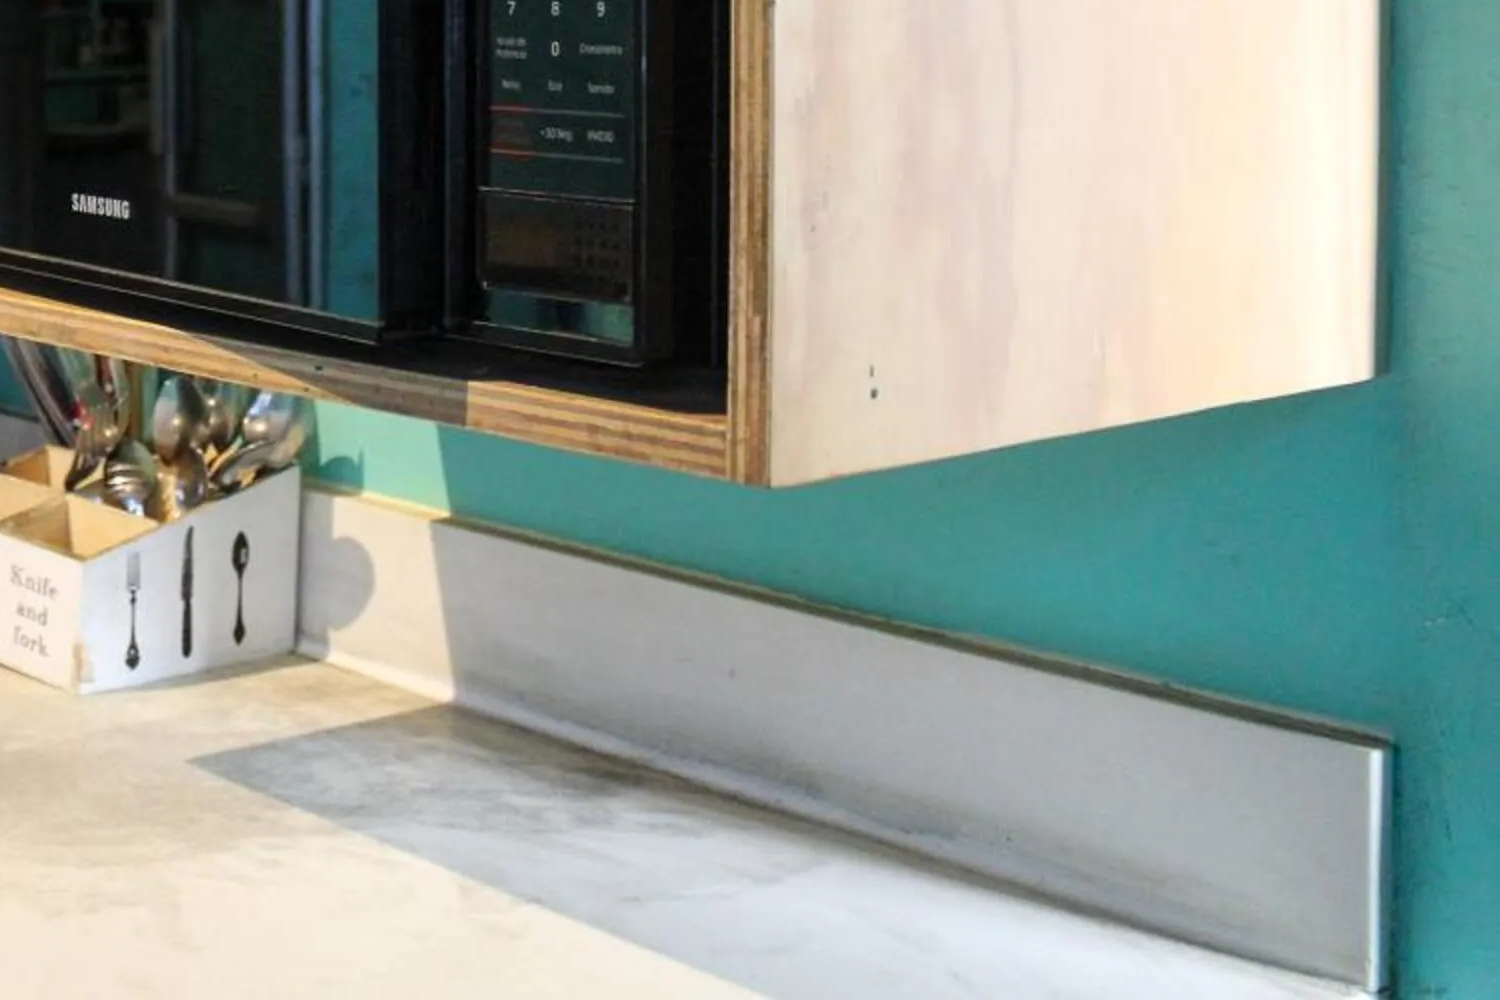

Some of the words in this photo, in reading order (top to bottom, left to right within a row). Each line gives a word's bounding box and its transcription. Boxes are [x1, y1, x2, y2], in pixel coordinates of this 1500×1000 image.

[506, 1, 516, 16] 7
[551, 1, 560, 16] 8
[596, 1, 606, 18] 9
[551, 41, 560, 57] 0
[71, 192, 130, 219] SAMSUNG
[10, 563, 59, 601] Knife
[16, 601, 49, 627] and
